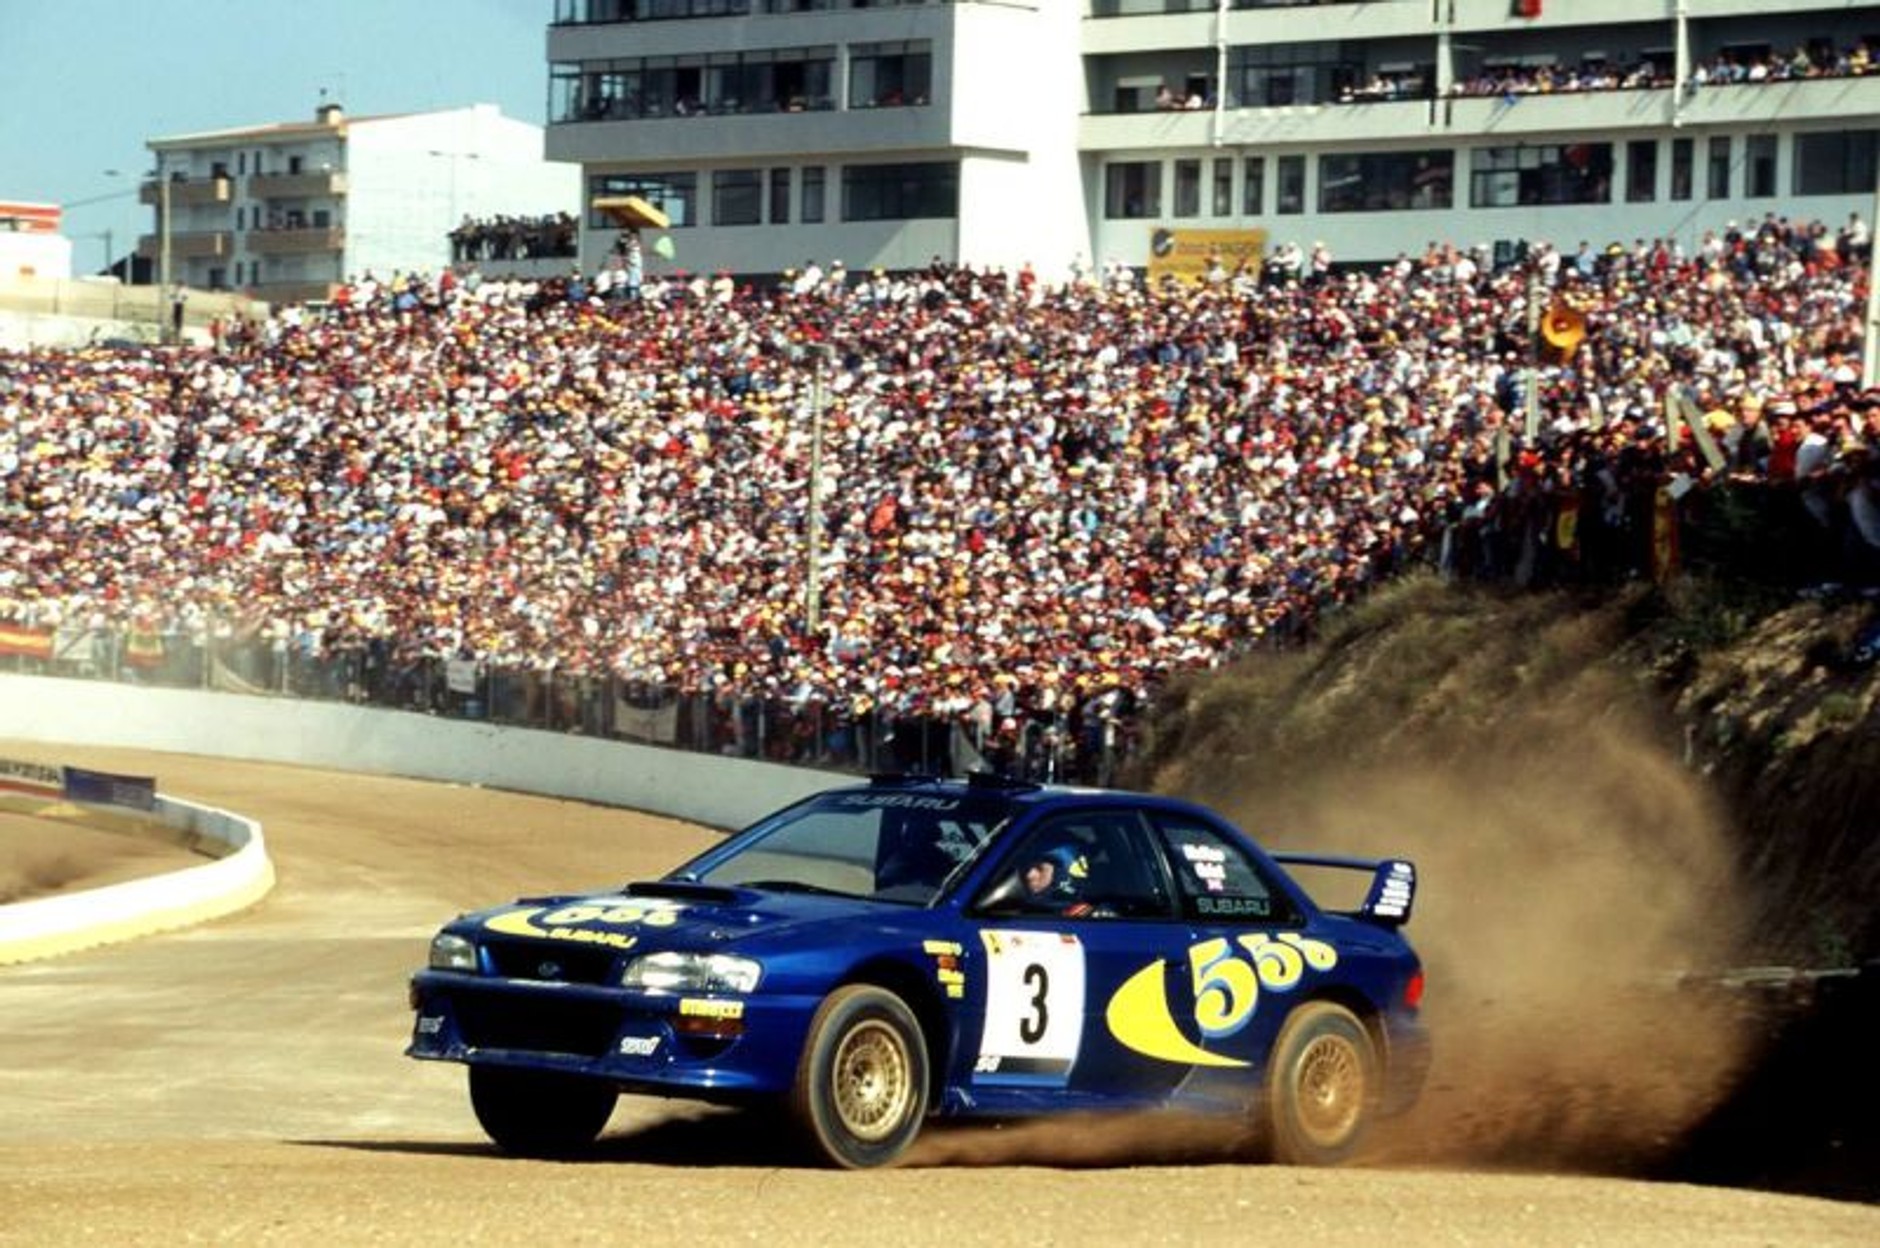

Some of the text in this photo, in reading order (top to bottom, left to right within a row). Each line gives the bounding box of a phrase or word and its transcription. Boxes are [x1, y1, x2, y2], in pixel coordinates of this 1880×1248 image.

[1197, 898, 1270, 915] SUBARU
[1020, 963, 1048, 1044] 3
[1188, 933, 1338, 1039] 555
